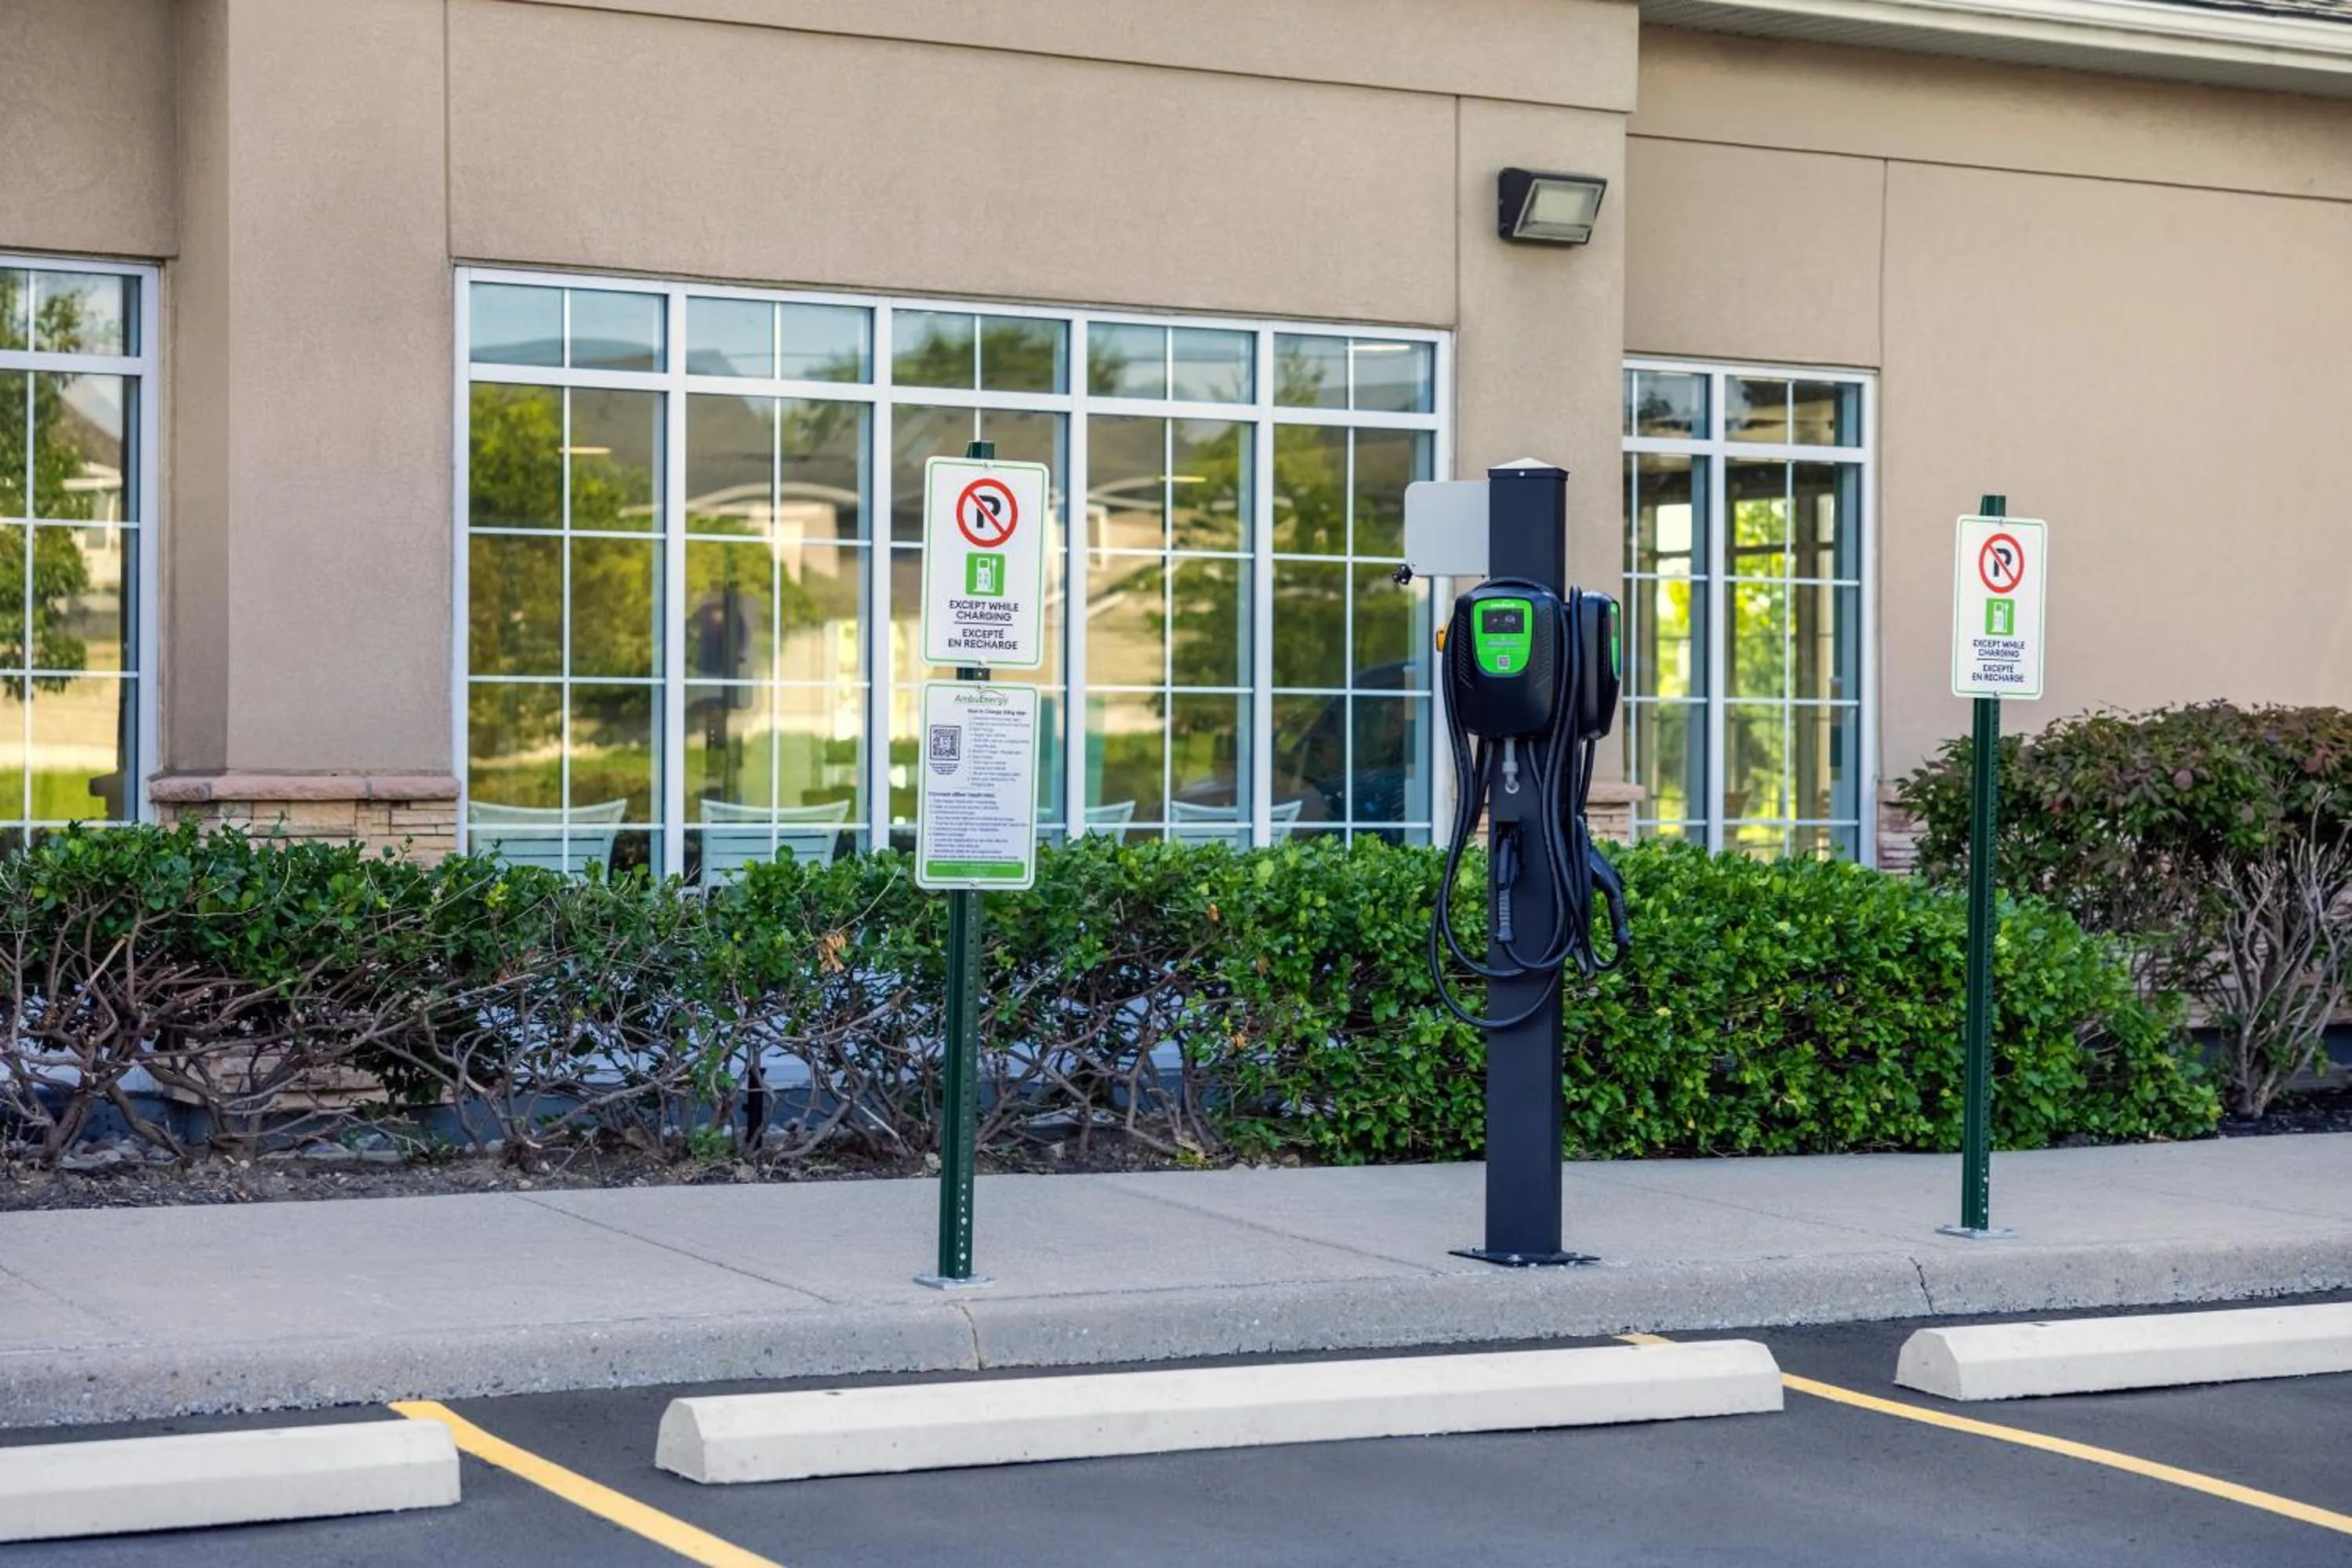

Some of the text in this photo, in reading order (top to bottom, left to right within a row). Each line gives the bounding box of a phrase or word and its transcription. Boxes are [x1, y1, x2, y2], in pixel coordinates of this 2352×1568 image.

[949, 600, 1019, 612] EXCEPT WHILE
[956, 611, 1012, 622] CHARGING
[962, 628, 1004, 638] EXCEPTÉ
[948, 638, 1018, 650] EN RECHARGE
[1973, 639, 2025, 649] EXCEPT WHILE
[1978, 648, 2020, 658] CHARGING
[1984, 673, 2024, 682] RECHARGE
